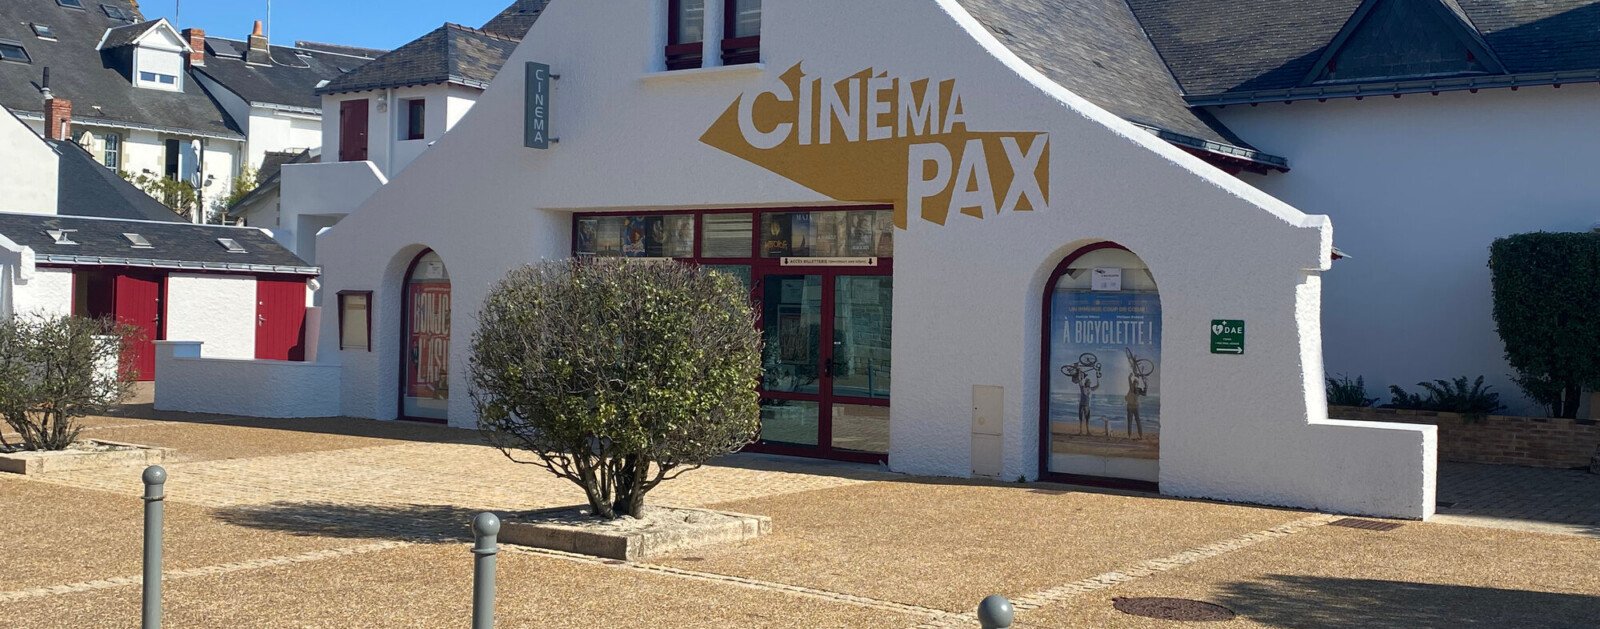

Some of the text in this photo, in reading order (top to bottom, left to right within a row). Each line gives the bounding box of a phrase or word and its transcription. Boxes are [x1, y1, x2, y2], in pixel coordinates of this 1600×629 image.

[533, 69, 544, 143] CINEMA
[737, 71, 967, 150] CINÉMA
[906, 132, 1049, 229] PAX
[414, 292, 450, 334] BONJO
[1063, 316, 1153, 345] À BICYCLETTE !
[418, 338, 451, 382] L'ASI
